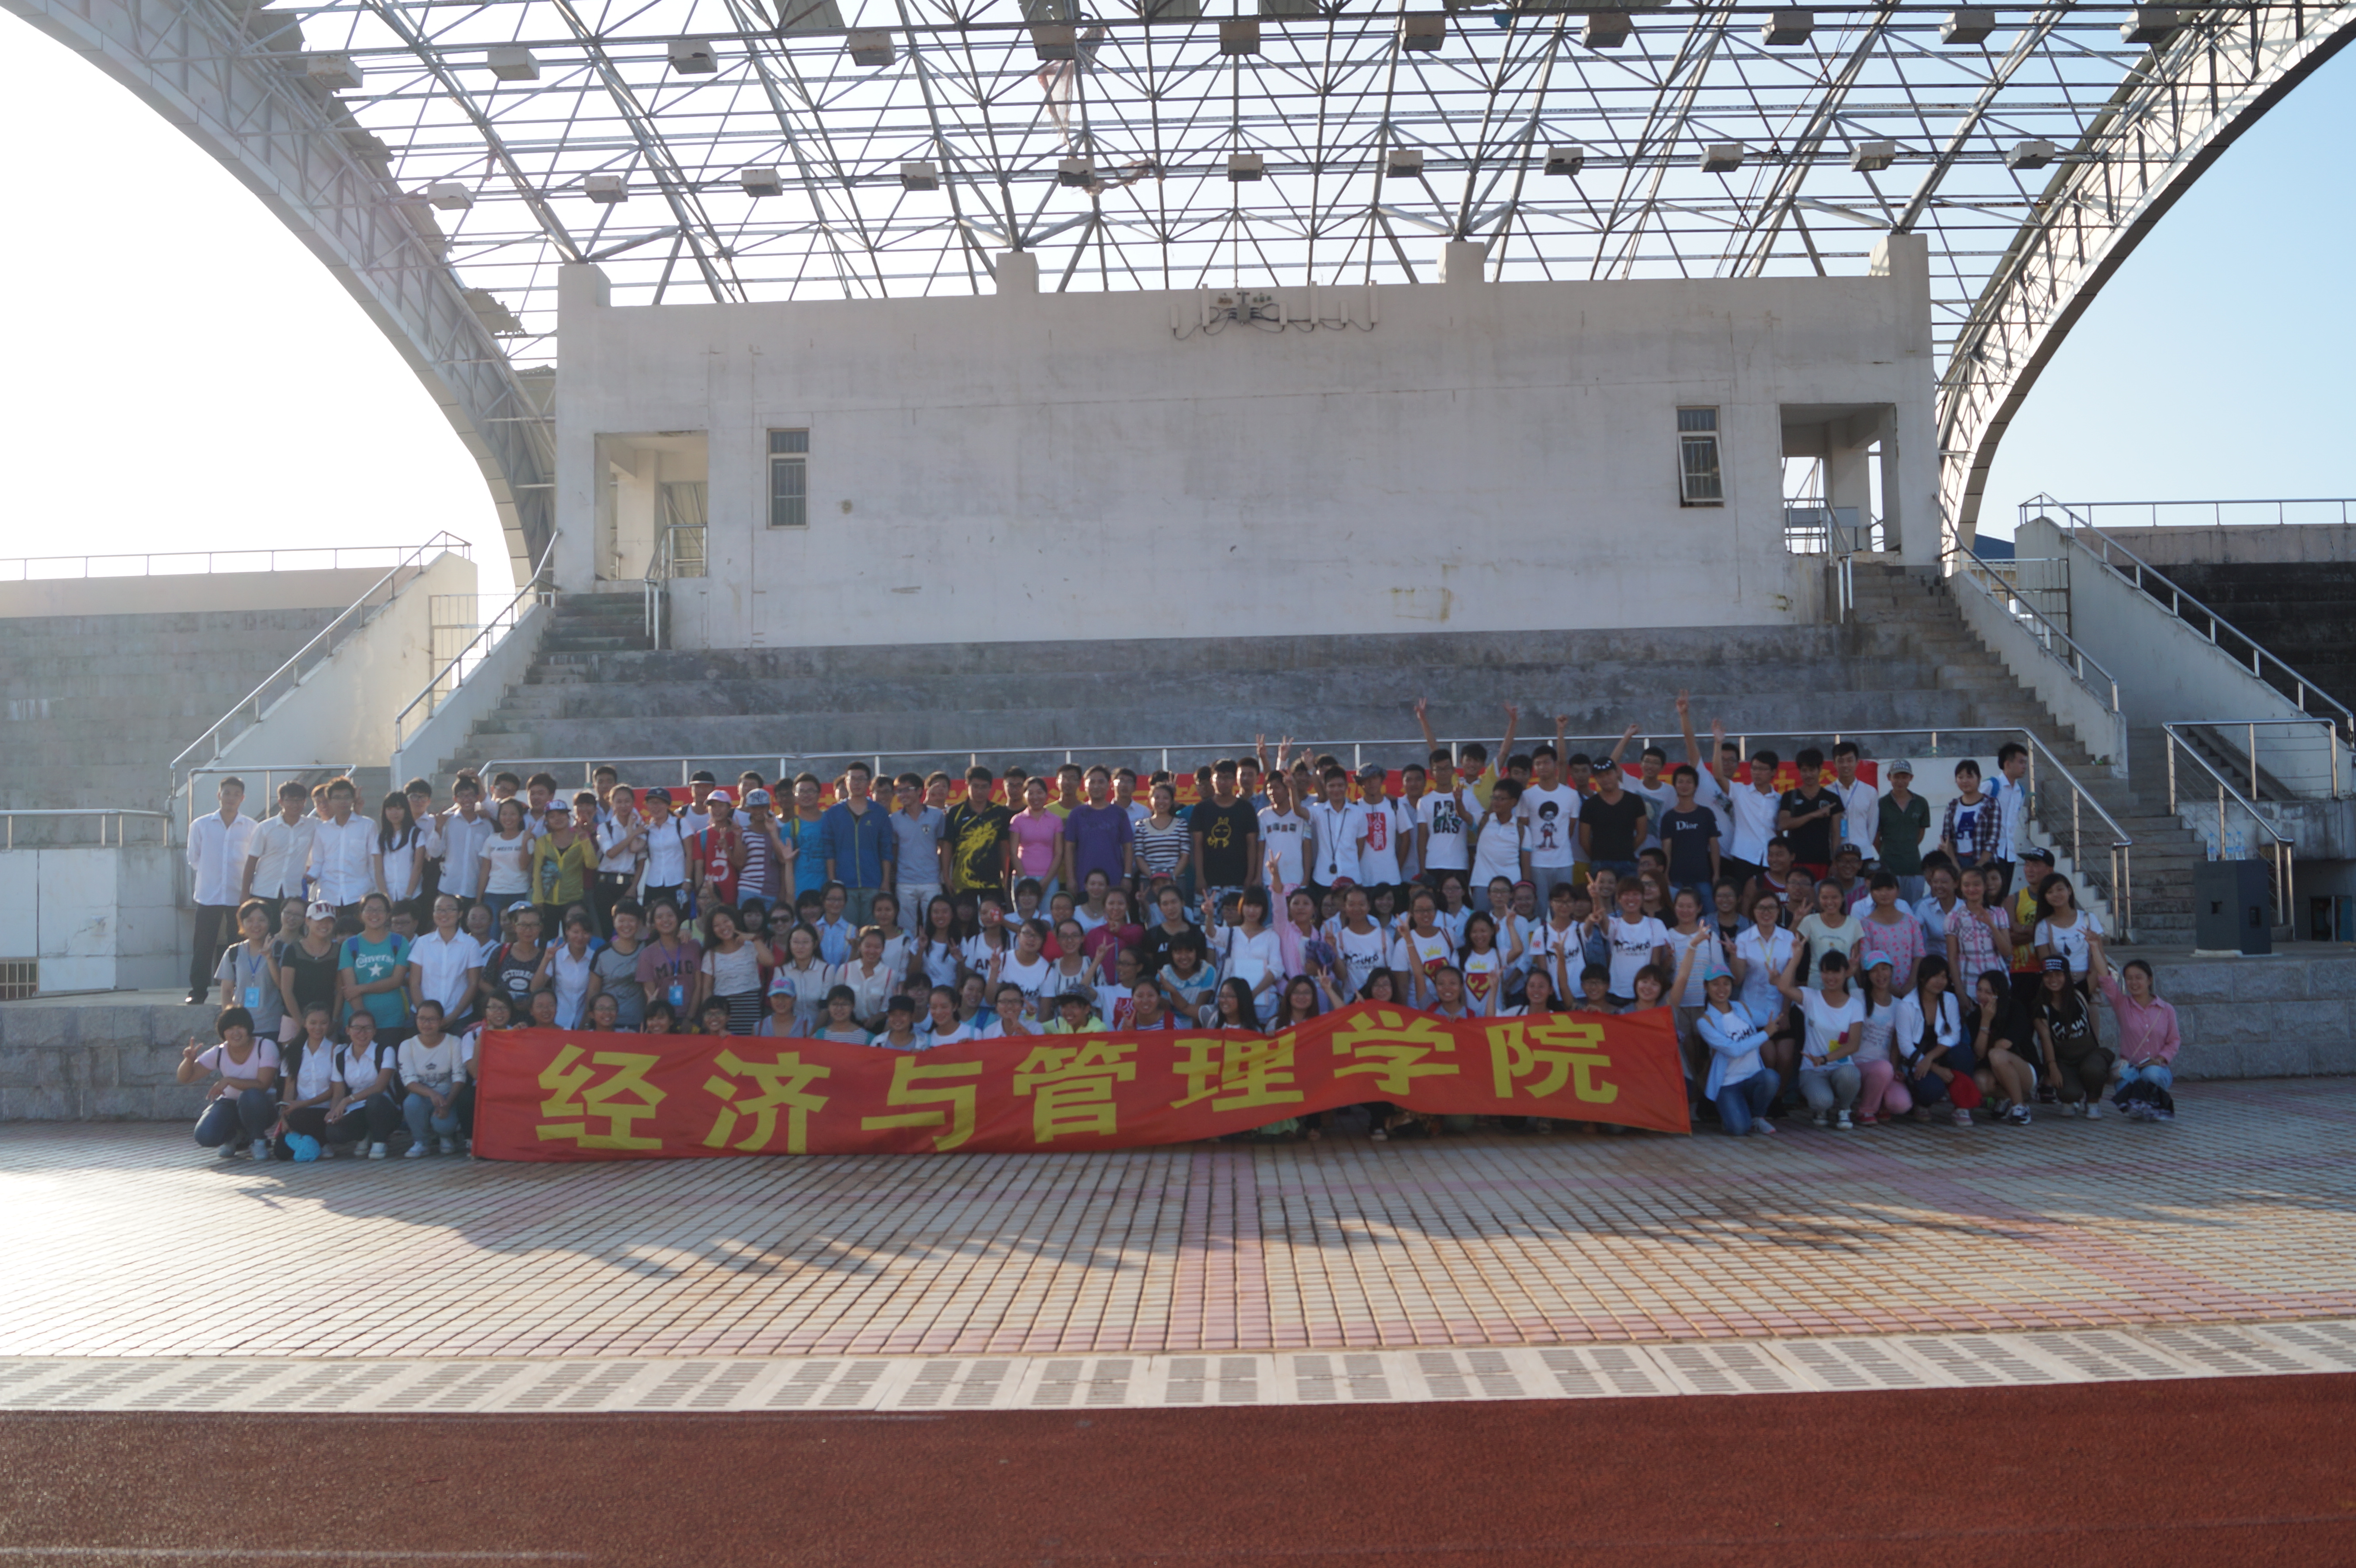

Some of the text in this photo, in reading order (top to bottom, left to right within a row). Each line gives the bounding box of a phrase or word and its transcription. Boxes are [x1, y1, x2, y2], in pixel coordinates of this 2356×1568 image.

[1675, 820, 1699, 831] Dior
[536, 1010, 1618, 1154] 经济与管理学院
